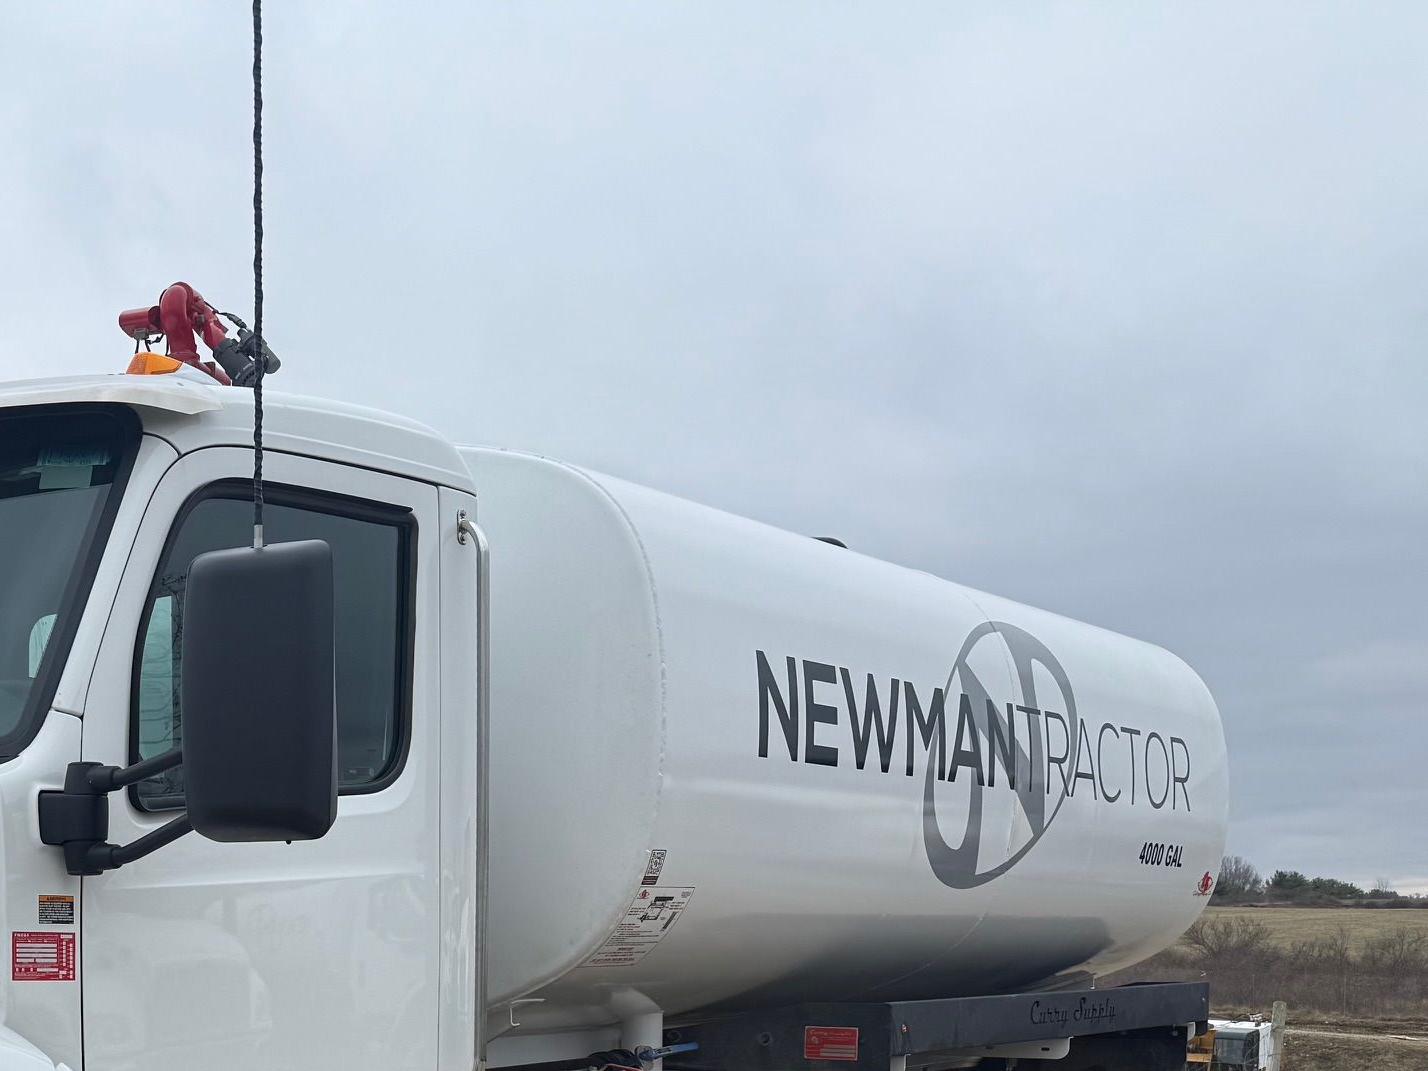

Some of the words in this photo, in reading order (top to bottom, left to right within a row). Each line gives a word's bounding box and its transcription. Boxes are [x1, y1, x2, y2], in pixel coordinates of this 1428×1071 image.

[1139, 842, 1165, 866] 4000
[1165, 844, 1183, 868] GAL
[1030, 1000, 1069, 1029] Curry
[1073, 996, 1117, 1024] Supply
